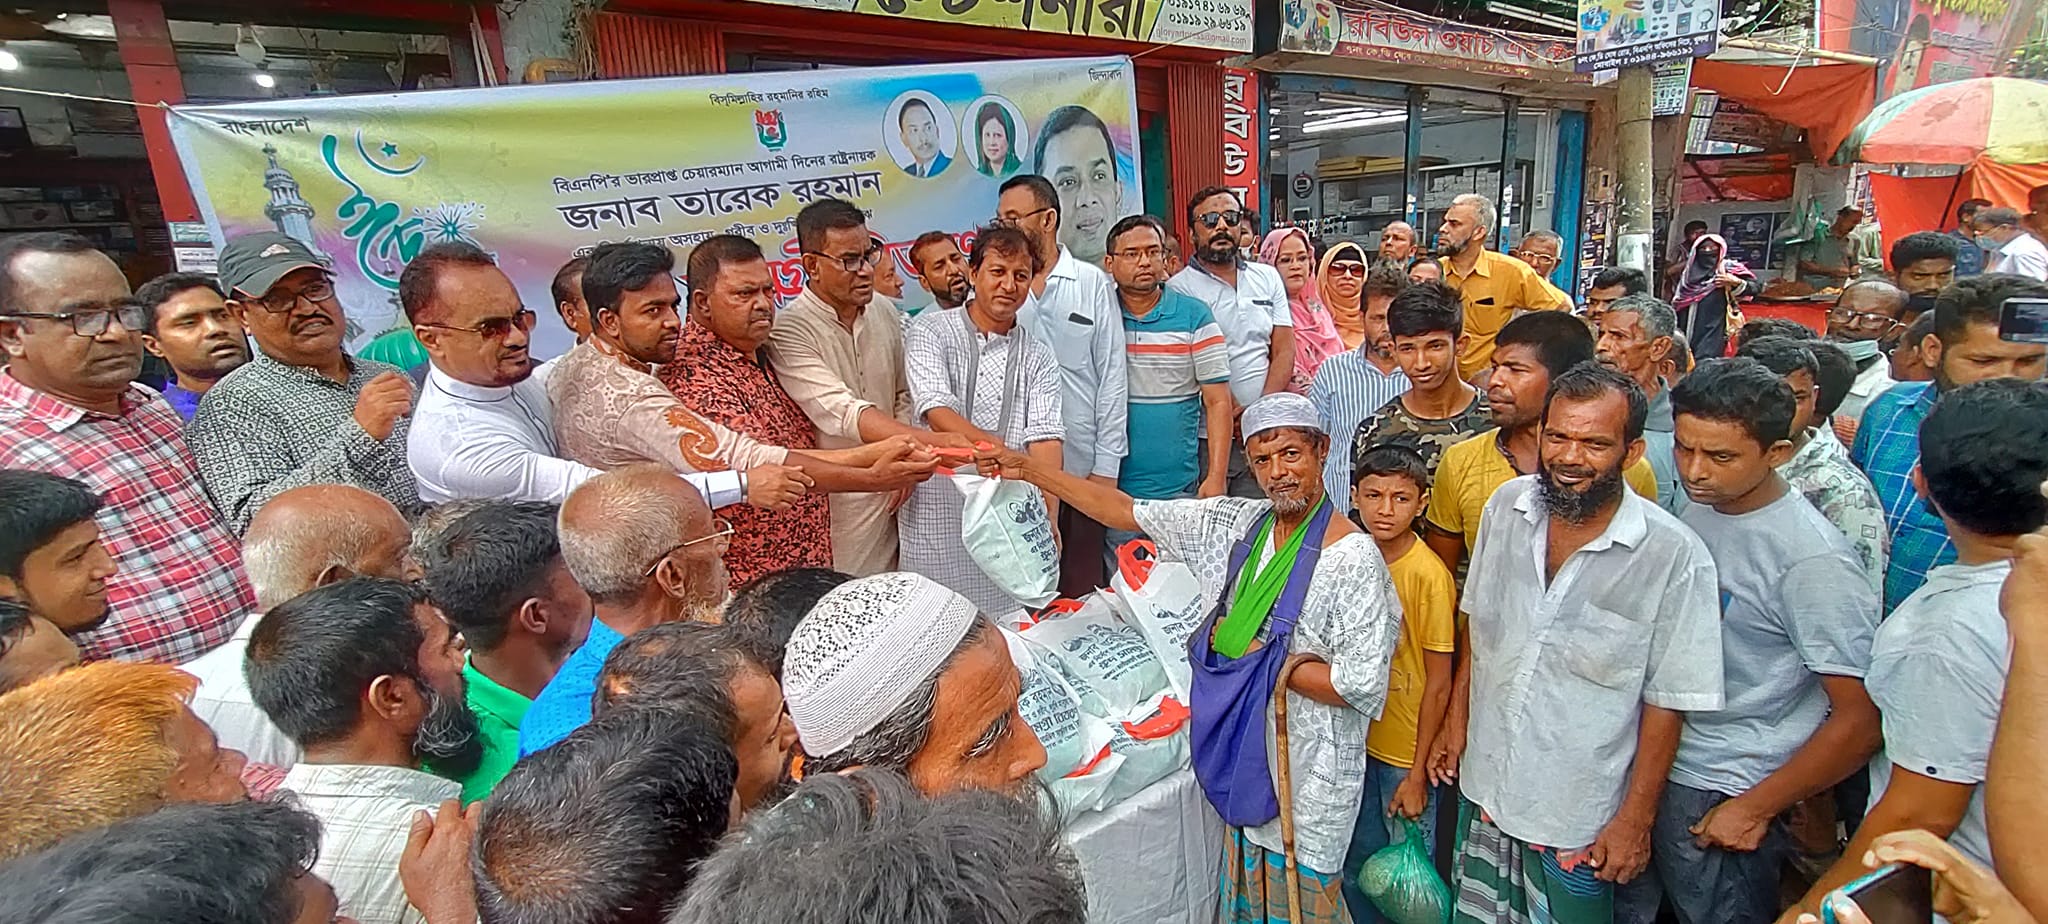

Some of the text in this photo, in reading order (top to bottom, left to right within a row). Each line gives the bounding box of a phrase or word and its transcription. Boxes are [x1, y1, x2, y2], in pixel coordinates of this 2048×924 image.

[1344, 11, 1430, 47] রবিউল
[806, 87, 829, 99] রহিম
[219, 116, 310, 136] বাংলাদেশ
[624, 169, 678, 185] ভারপ্রাপ্ত
[682, 162, 743, 181] চেয়ারম্যান
[747, 155, 788, 174] আগামী
[792, 153, 826, 168] দিনের
[829, 150, 877, 166] রাষ্ট্রনায়ক
[557, 171, 882, 230] জনাব তারেক রহমান
[759, 224, 770, 235] ও
